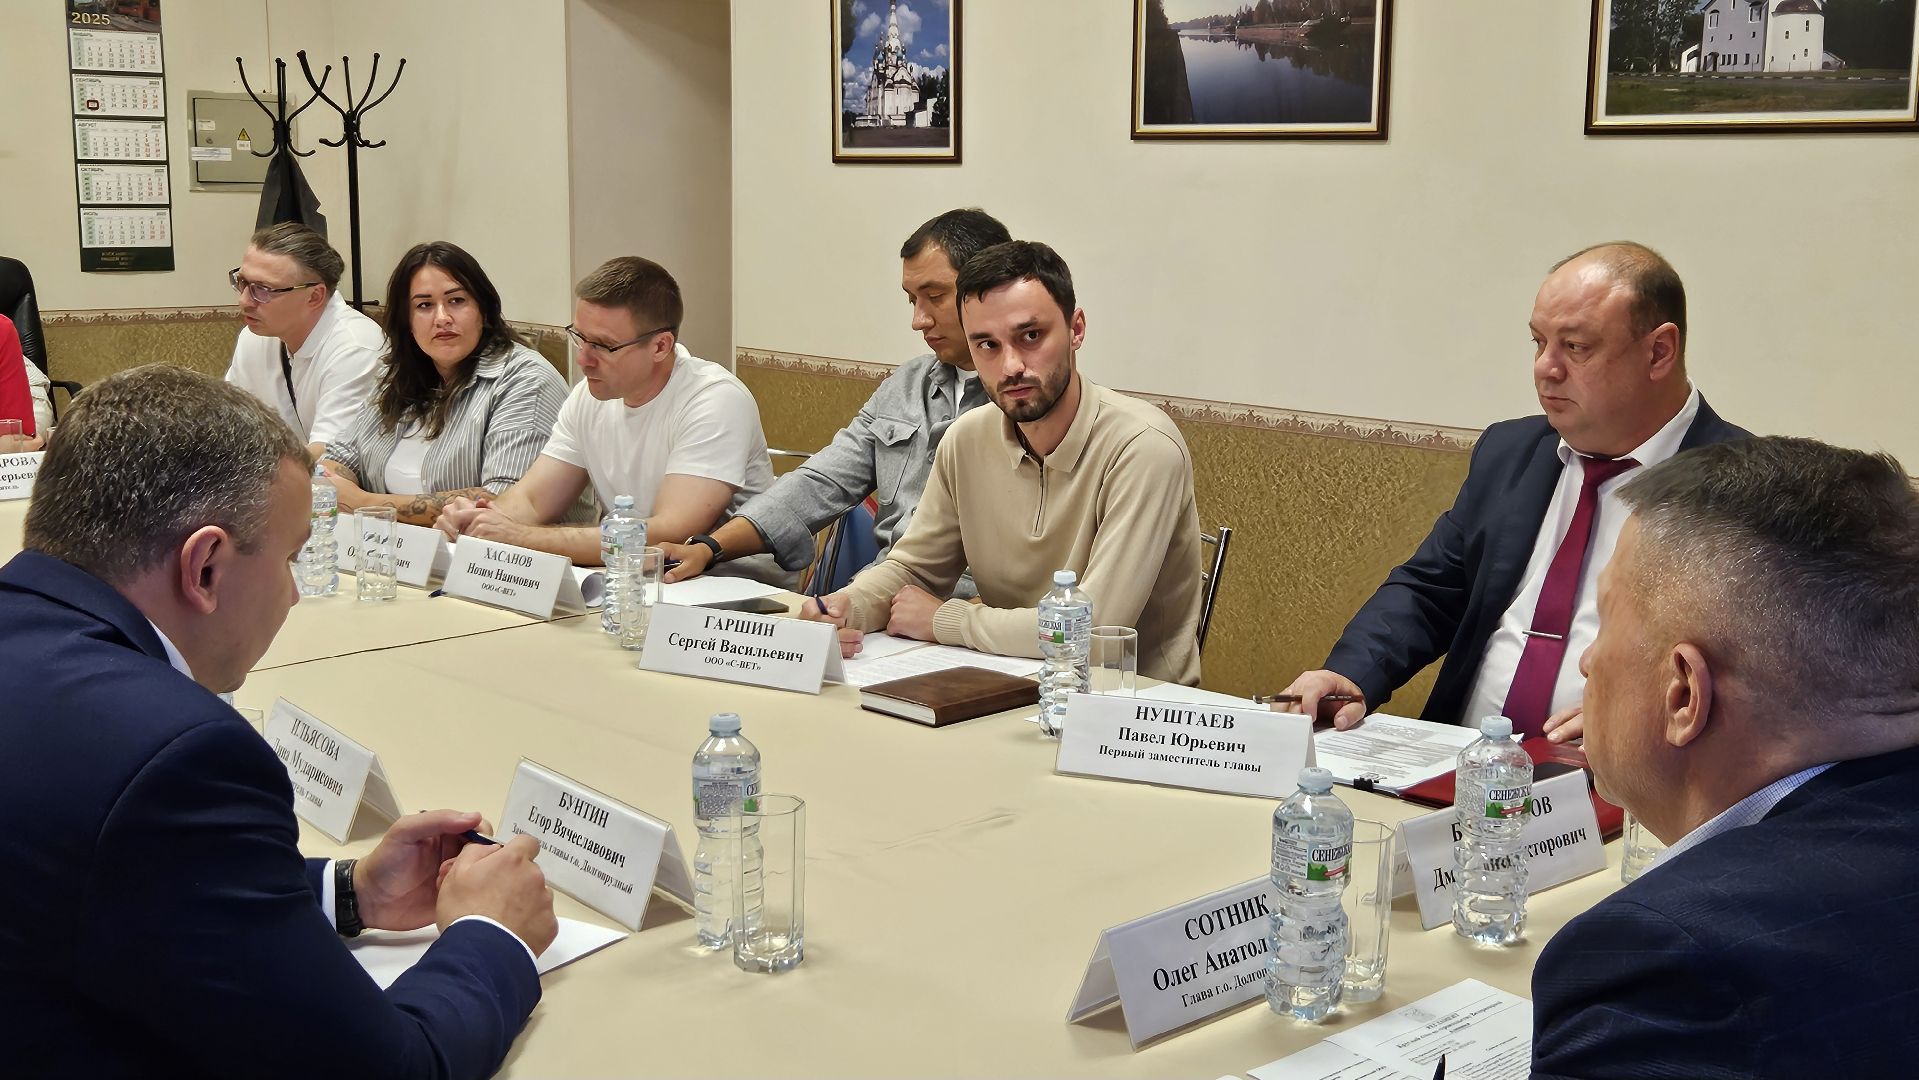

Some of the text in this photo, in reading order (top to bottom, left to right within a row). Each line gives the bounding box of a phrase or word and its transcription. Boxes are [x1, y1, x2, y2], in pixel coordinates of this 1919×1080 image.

[71, 12, 111, 26] 2025
[0, 471, 37, 482] ерьев
[484, 547, 533, 568] ХАСАНОВ
[467, 563, 540, 590] Нозим Наимович
[481, 583, 494, 592] ООО
[704, 615, 776, 637] ГАРШИН
[668, 632, 804, 663] Сергей Васильевич
[704, 656, 761, 671] ООО «С-ВЕТ»
[1135, 705, 1235, 730] НУШТАЕВ
[290, 718, 341, 761] ИЛЬЯСОВА
[1118, 726, 1246, 754] Павел Юрьевич
[289, 749, 344, 797] Мударисовна
[1099, 745, 1262, 774] Первый заместитель главы
[558, 791, 610, 829] БУНТИН
[528, 805, 552, 834] Егор
[552, 818, 626, 869] Вячеславович
[1526, 827, 1587, 859] кторович
[549, 845, 569, 862] главы
[580, 860, 633, 895] Долгопрудный
[1184, 893, 1270, 941] СОТНИК
[1153, 937, 1268, 991] Олег Анатол
[1181, 967, 1268, 1008] Глава г.о. Долгоп
